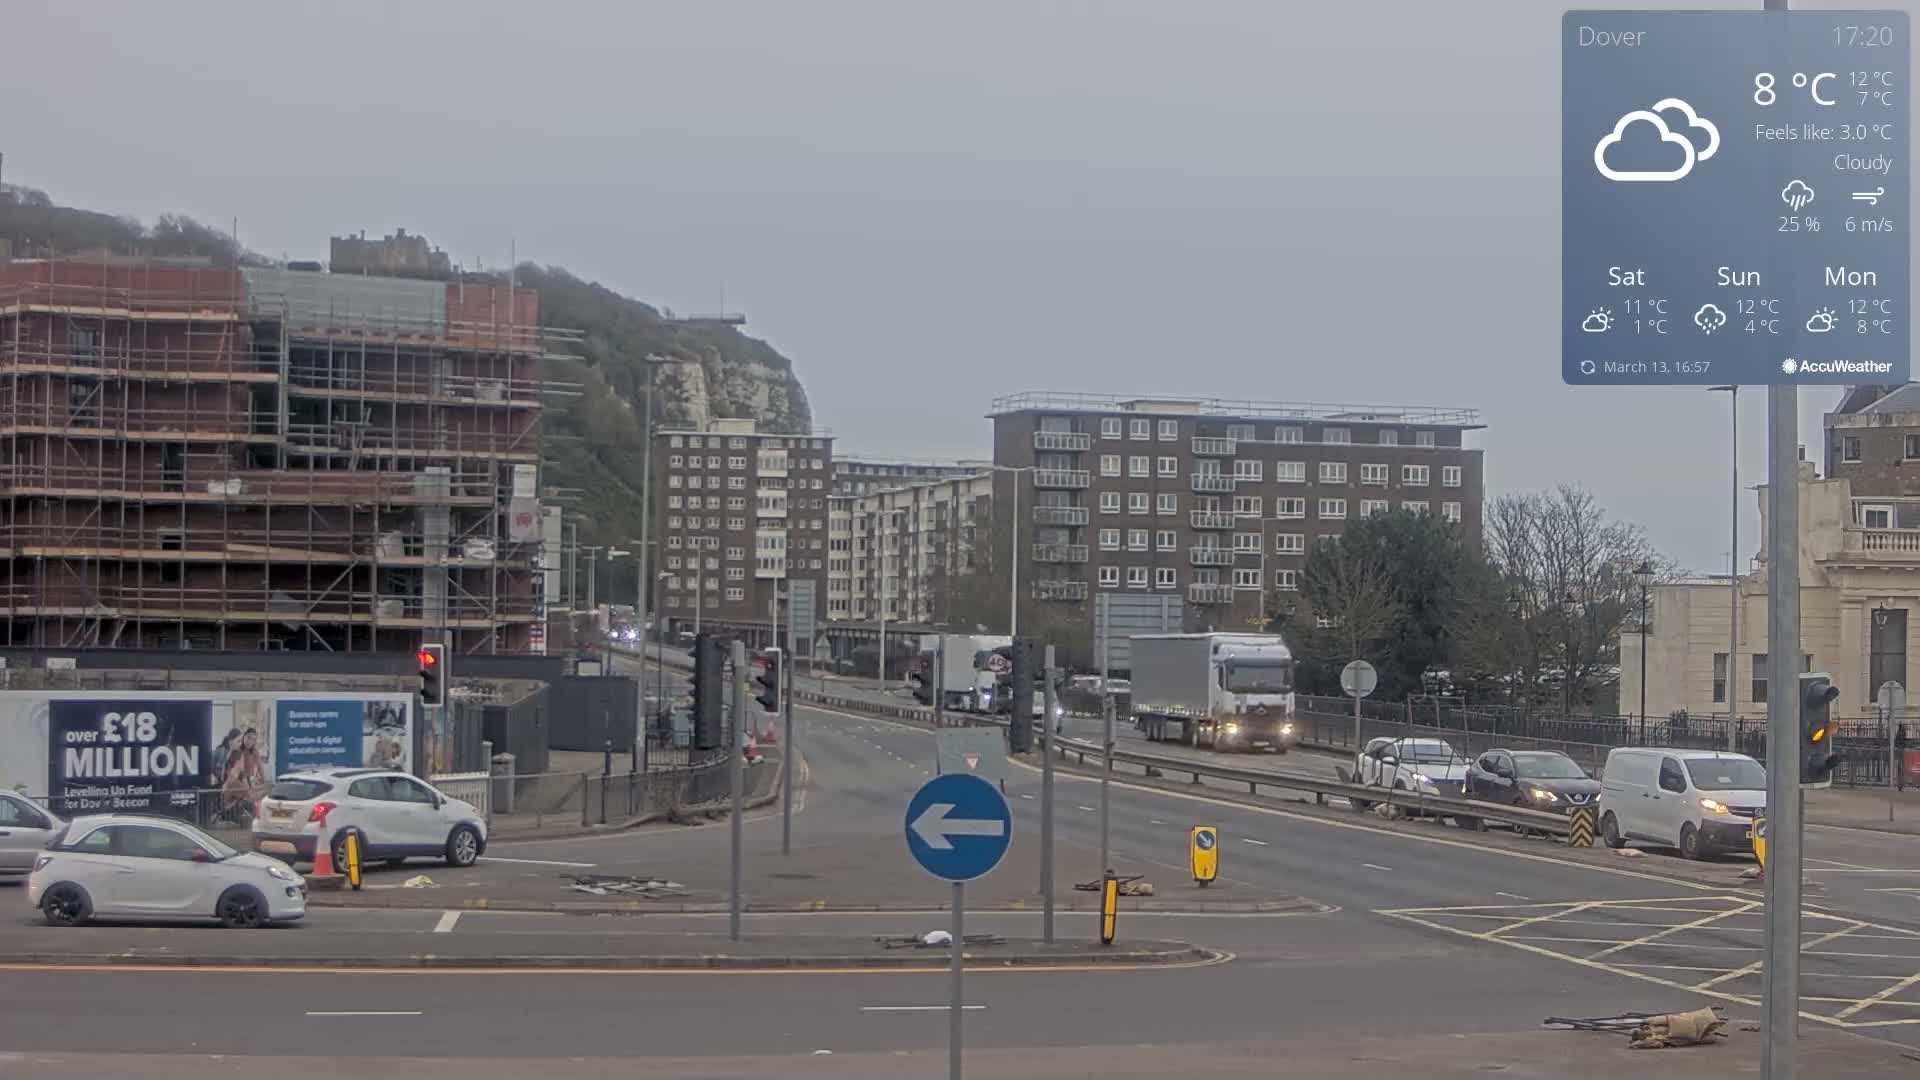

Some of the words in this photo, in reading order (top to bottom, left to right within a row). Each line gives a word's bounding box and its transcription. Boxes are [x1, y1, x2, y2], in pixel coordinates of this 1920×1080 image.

[66, 730, 98, 743] over
[103, 711, 157, 743] £18
[65, 745, 199, 778] MILLION
[64, 786, 109, 797] Levelling
[110, 785, 126, 796] Up
[127, 784, 153, 795] Fund
[64, 798, 78, 809] for
[80, 798, 110, 809] Dovr
[113, 798, 150, 808] Beacon
